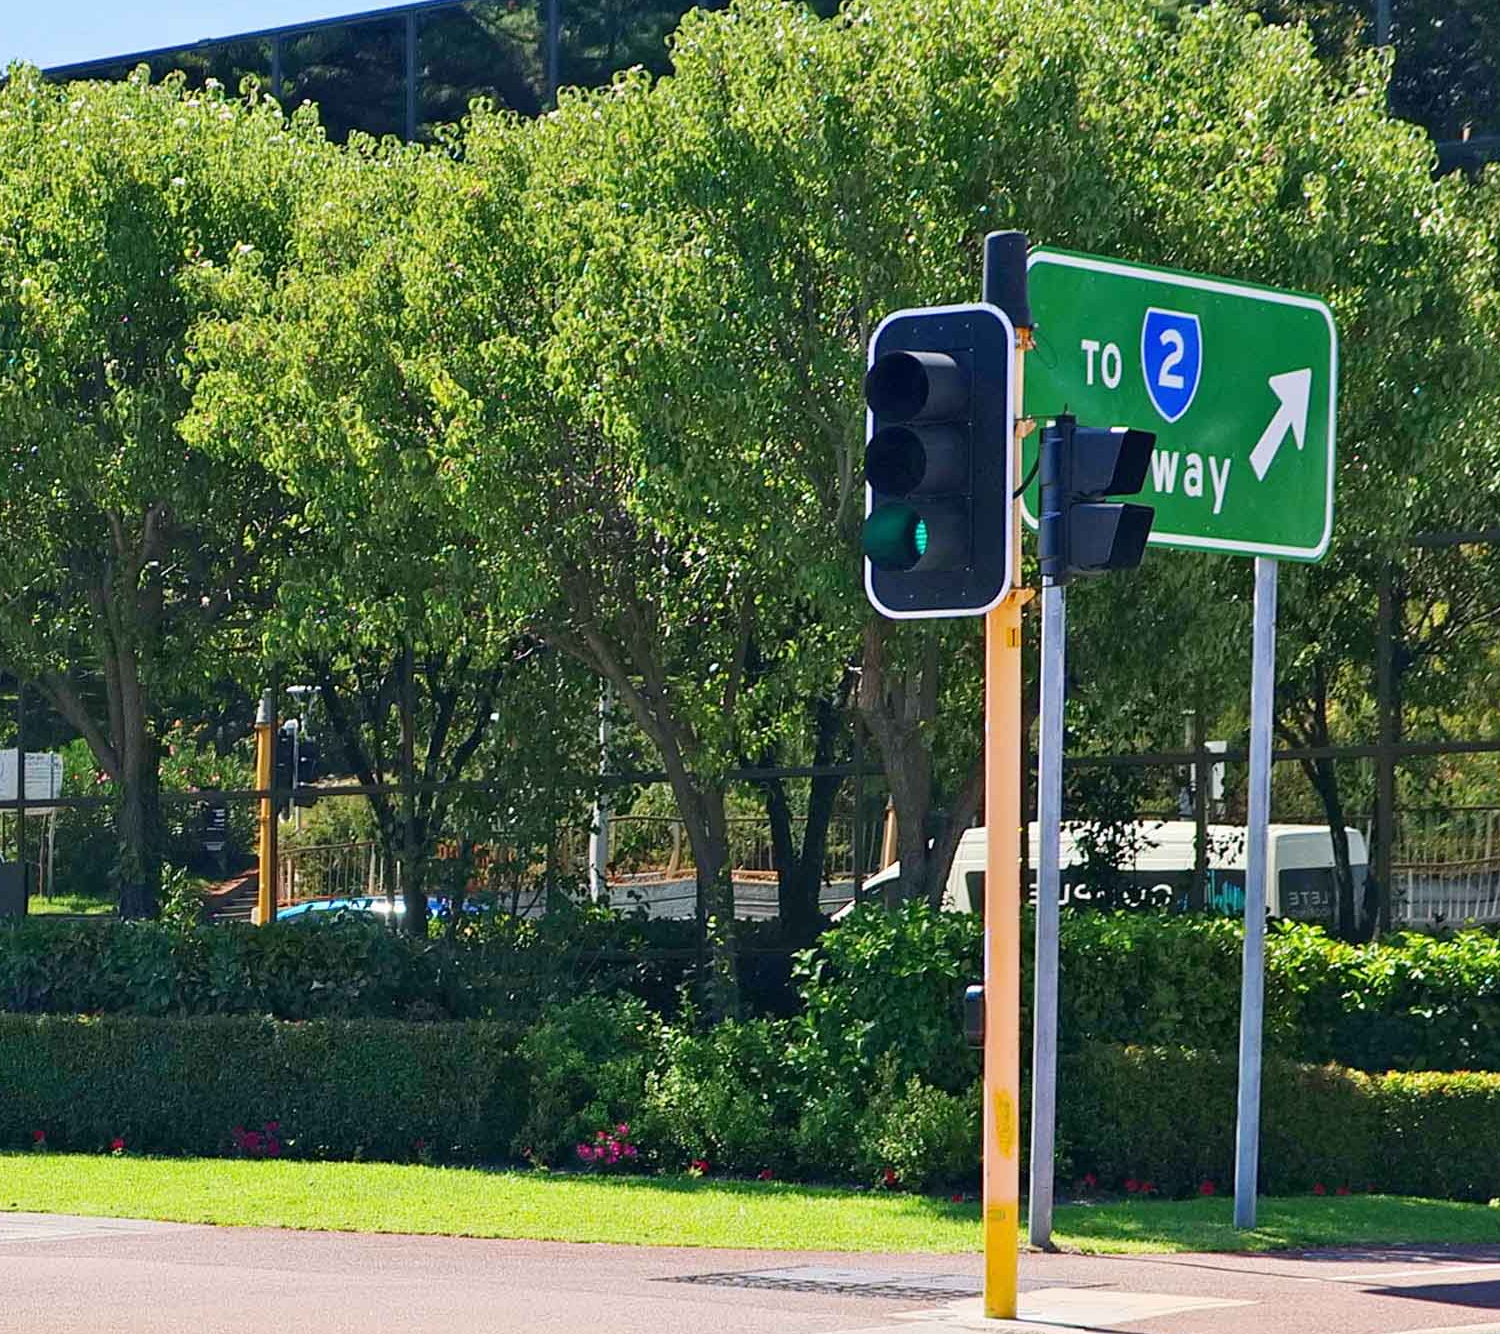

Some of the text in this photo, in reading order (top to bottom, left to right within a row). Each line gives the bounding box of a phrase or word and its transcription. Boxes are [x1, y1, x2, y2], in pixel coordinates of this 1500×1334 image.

[1080, 328, 1185, 390] TO 2
[1150, 448, 1232, 515] way
